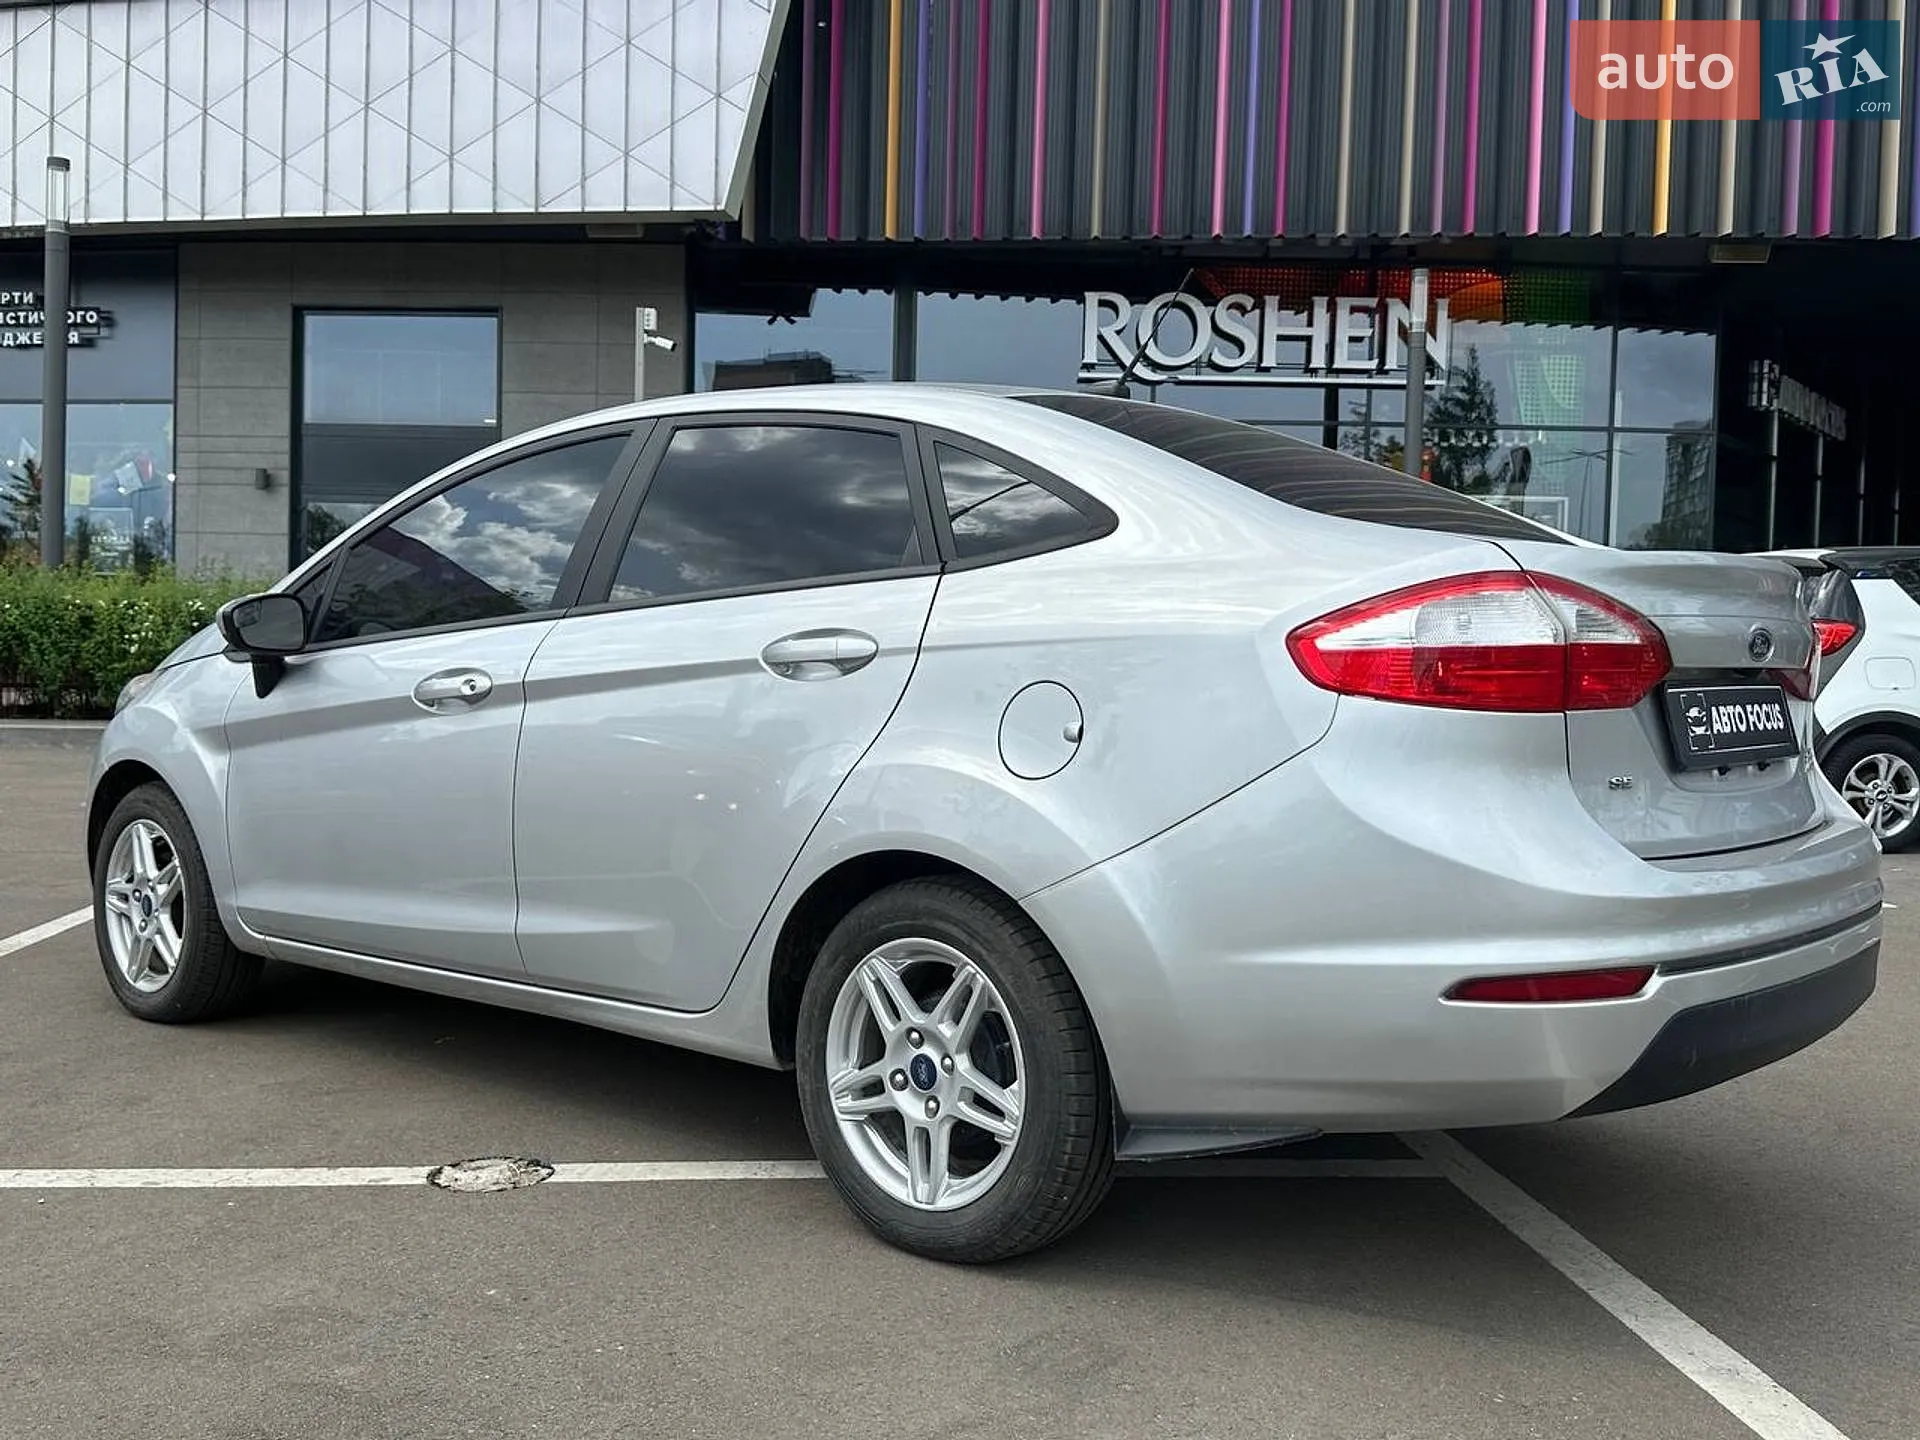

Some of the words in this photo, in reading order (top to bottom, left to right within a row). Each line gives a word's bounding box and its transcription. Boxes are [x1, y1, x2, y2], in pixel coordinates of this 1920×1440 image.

[0, 291, 33, 304] РТИ
[0, 331, 79, 347] ДЖЕЯ
[1081, 291, 1450, 384] ROSHEN
[1745, 703, 1785, 731] FOCUS
